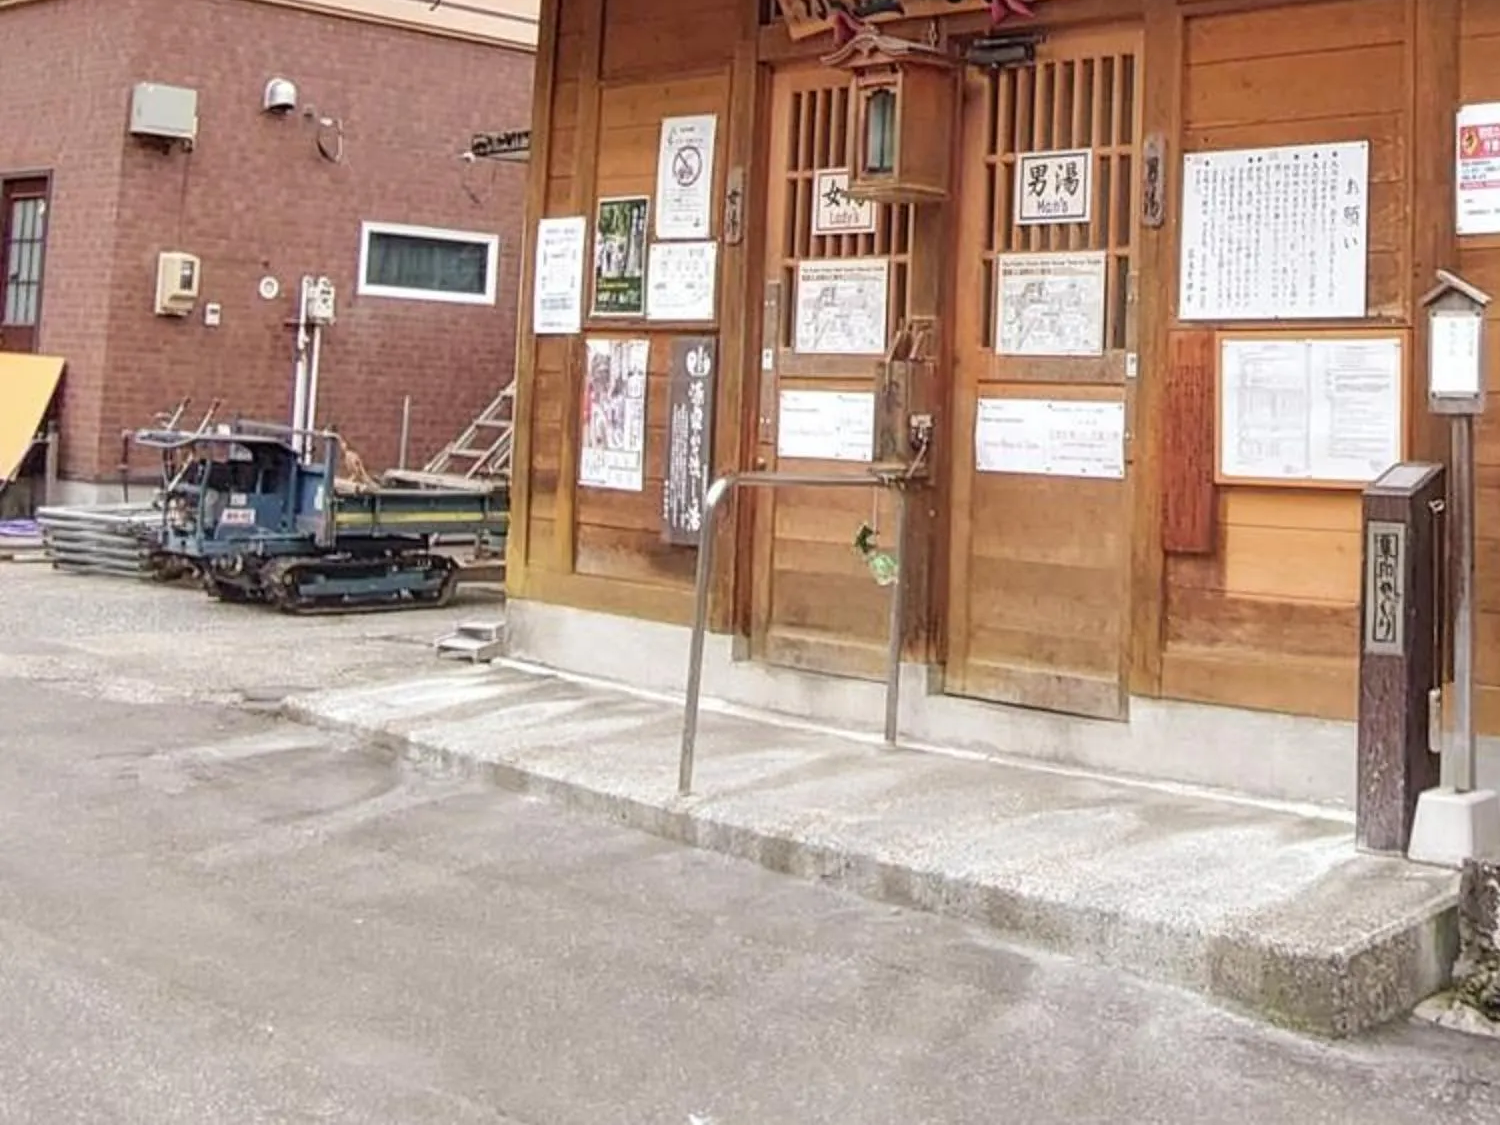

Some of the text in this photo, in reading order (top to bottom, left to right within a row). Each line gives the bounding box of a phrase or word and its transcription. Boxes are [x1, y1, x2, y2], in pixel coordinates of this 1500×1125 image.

[821, 179, 864, 207] 女
[1027, 161, 1080, 197] 男湯
[1343, 178, 1361, 250] お願い
